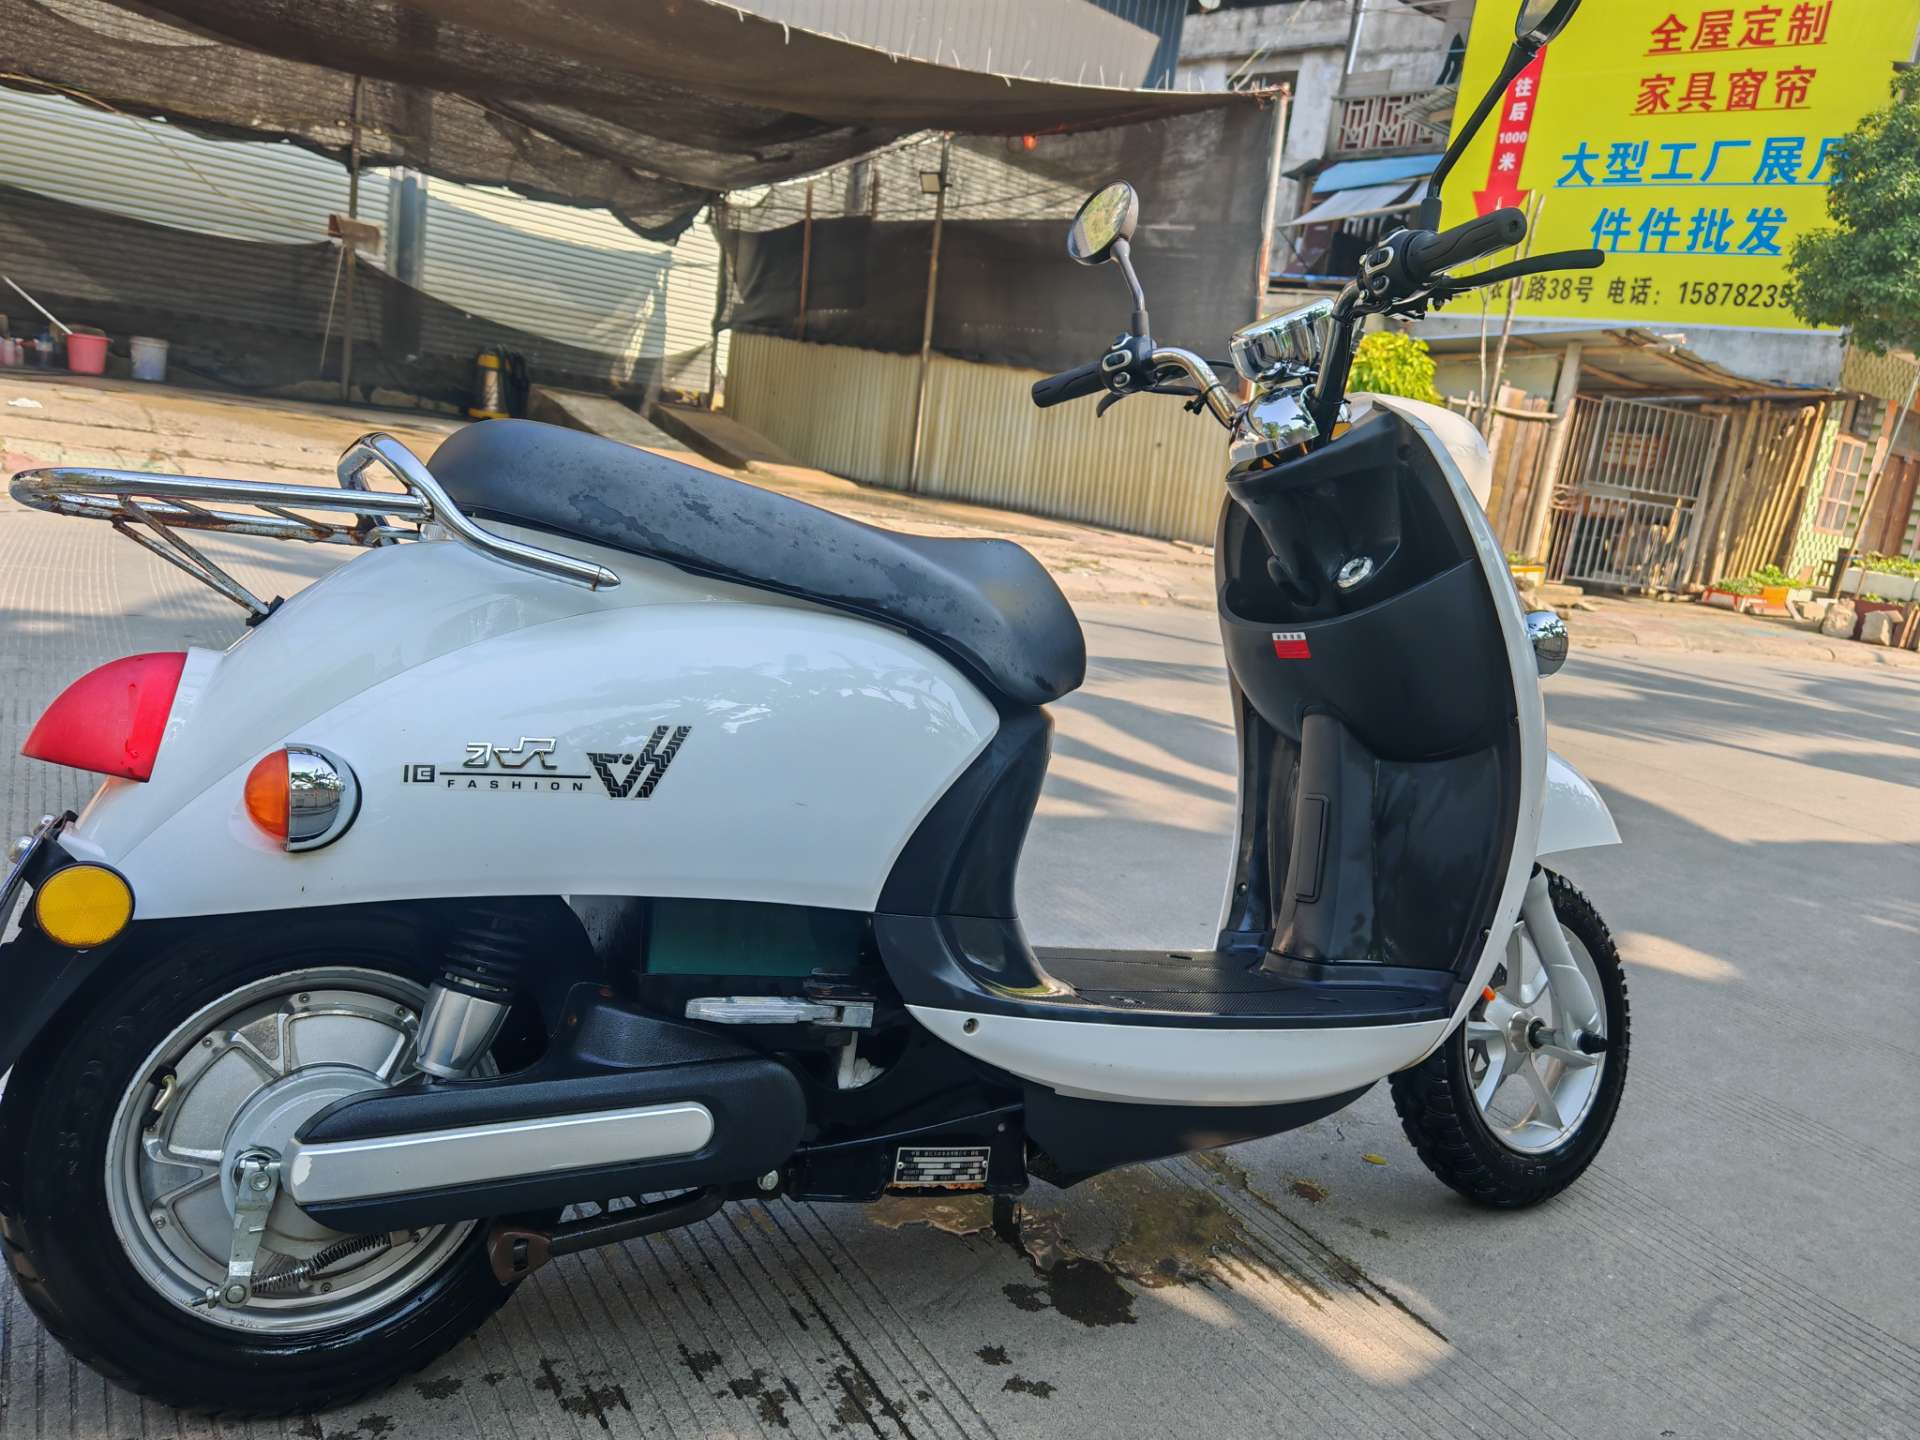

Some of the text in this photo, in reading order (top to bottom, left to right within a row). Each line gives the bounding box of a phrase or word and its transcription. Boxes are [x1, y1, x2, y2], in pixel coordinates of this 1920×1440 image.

[1648, 1, 1833, 55] 全屋定制
[1635, 65, 1817, 113] 家具窗帘
[1590, 207, 1788, 253] 件件批发
[447, 780, 583, 791] FASHION
